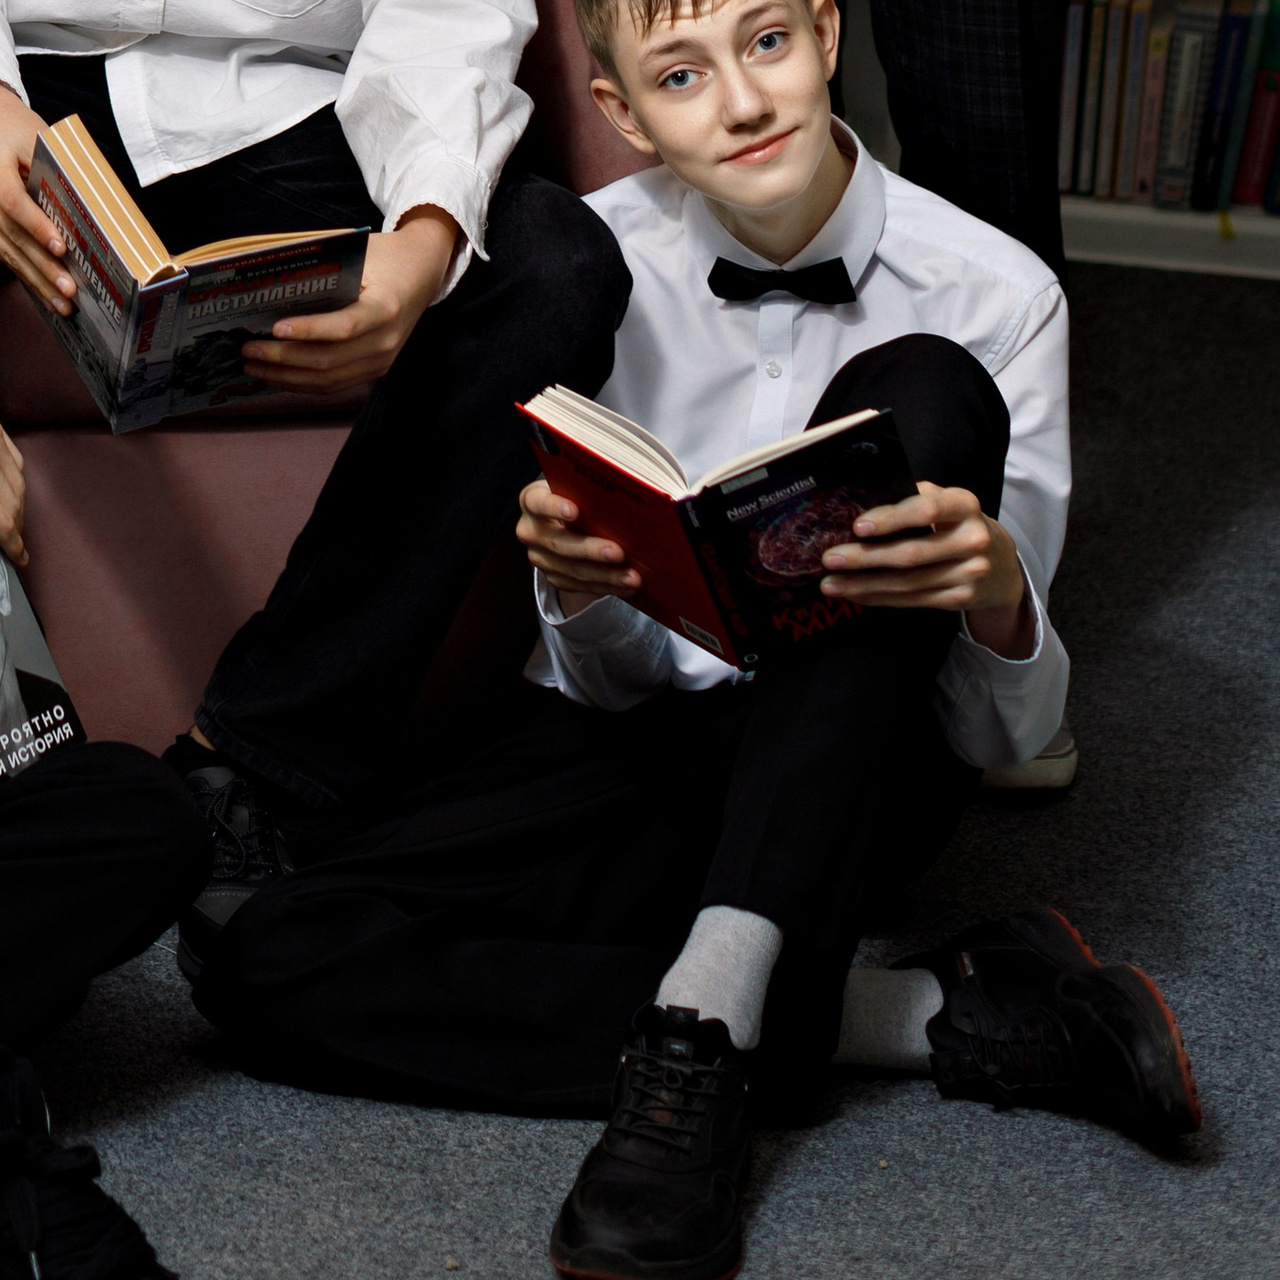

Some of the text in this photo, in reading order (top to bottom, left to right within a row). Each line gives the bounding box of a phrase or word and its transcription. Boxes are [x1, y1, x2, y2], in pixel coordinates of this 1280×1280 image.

[38, 189, 122, 325] НАСТУПЛЕНИЕ
[187, 275, 340, 320] НАСТУПЛЕНИЕ
[726, 498, 758, 520] New
[758, 476, 818, 505] Scientist
[7, 722, 75, 768] ИСТОРИЯ
